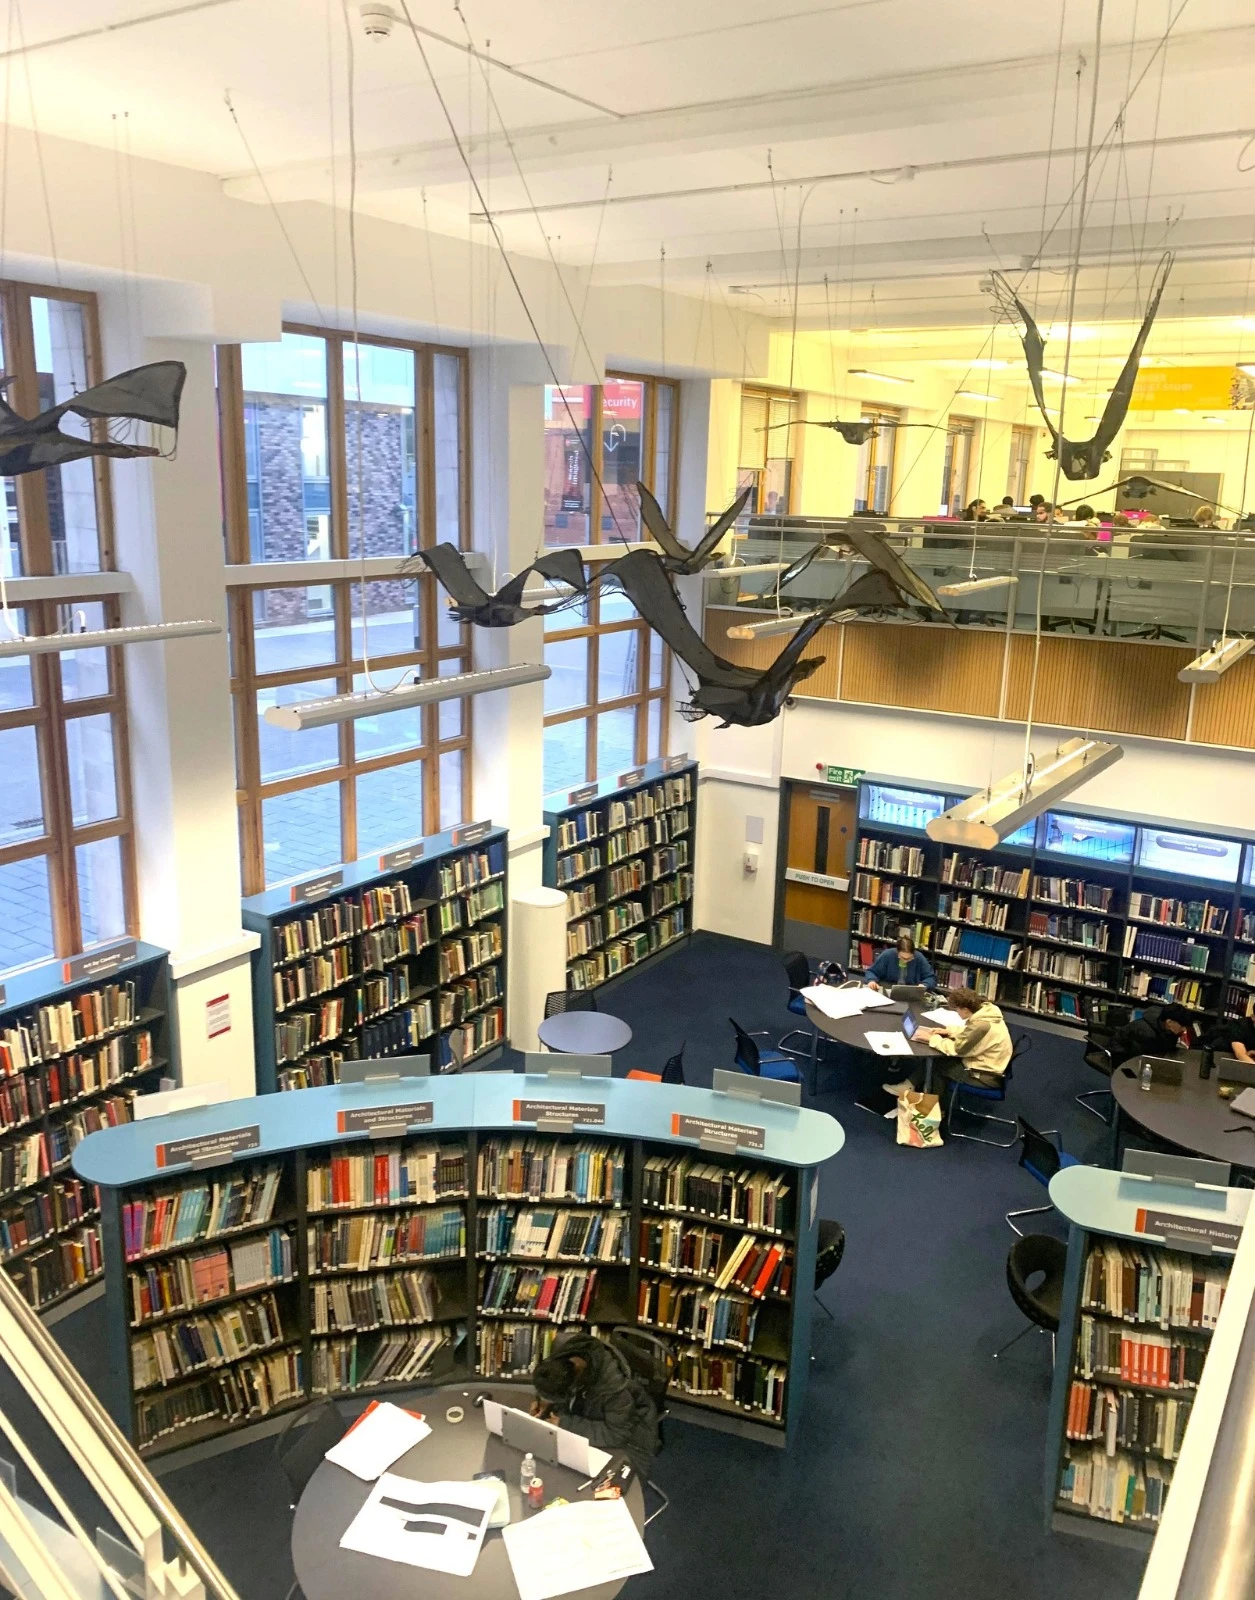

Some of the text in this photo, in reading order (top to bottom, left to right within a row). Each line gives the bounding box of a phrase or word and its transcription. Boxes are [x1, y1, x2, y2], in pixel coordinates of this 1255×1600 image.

[603, 396, 637, 409] ecurity
[828, 767, 843, 776] Fire
[828, 775, 843, 783] exit
[795, 873, 810, 881] PUSH
[819, 878, 835, 886] OPEN
[350, 1105, 426, 1118] Architectural Materials
[526, 1103, 598, 1113] Architectural Materials
[378, 1113, 413, 1122] Structures
[685, 1118, 758, 1136] Architectural Materials
[704, 1128, 738, 1139] Structures
[170, 1132, 252, 1153] Architectural Materials
[186, 1141, 239, 1156] and Structures
[1154, 1220, 1239, 1241] Architectural History
